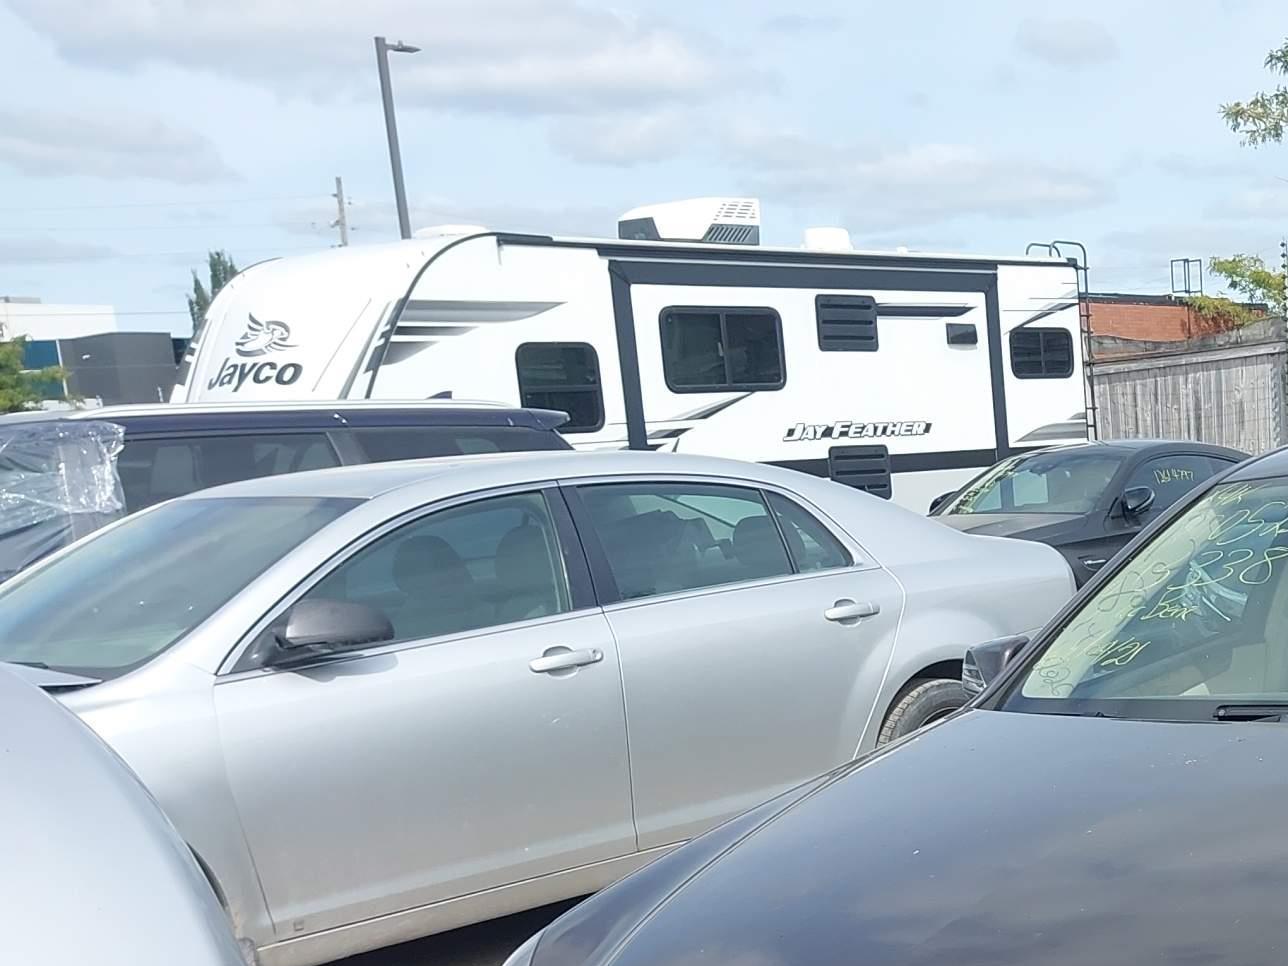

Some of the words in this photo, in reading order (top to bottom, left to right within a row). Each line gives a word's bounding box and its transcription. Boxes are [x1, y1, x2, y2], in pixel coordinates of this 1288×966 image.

[207, 357, 303, 393] Jayco
[783, 423, 827, 442] JAY
[831, 421, 927, 439] FEATHER
